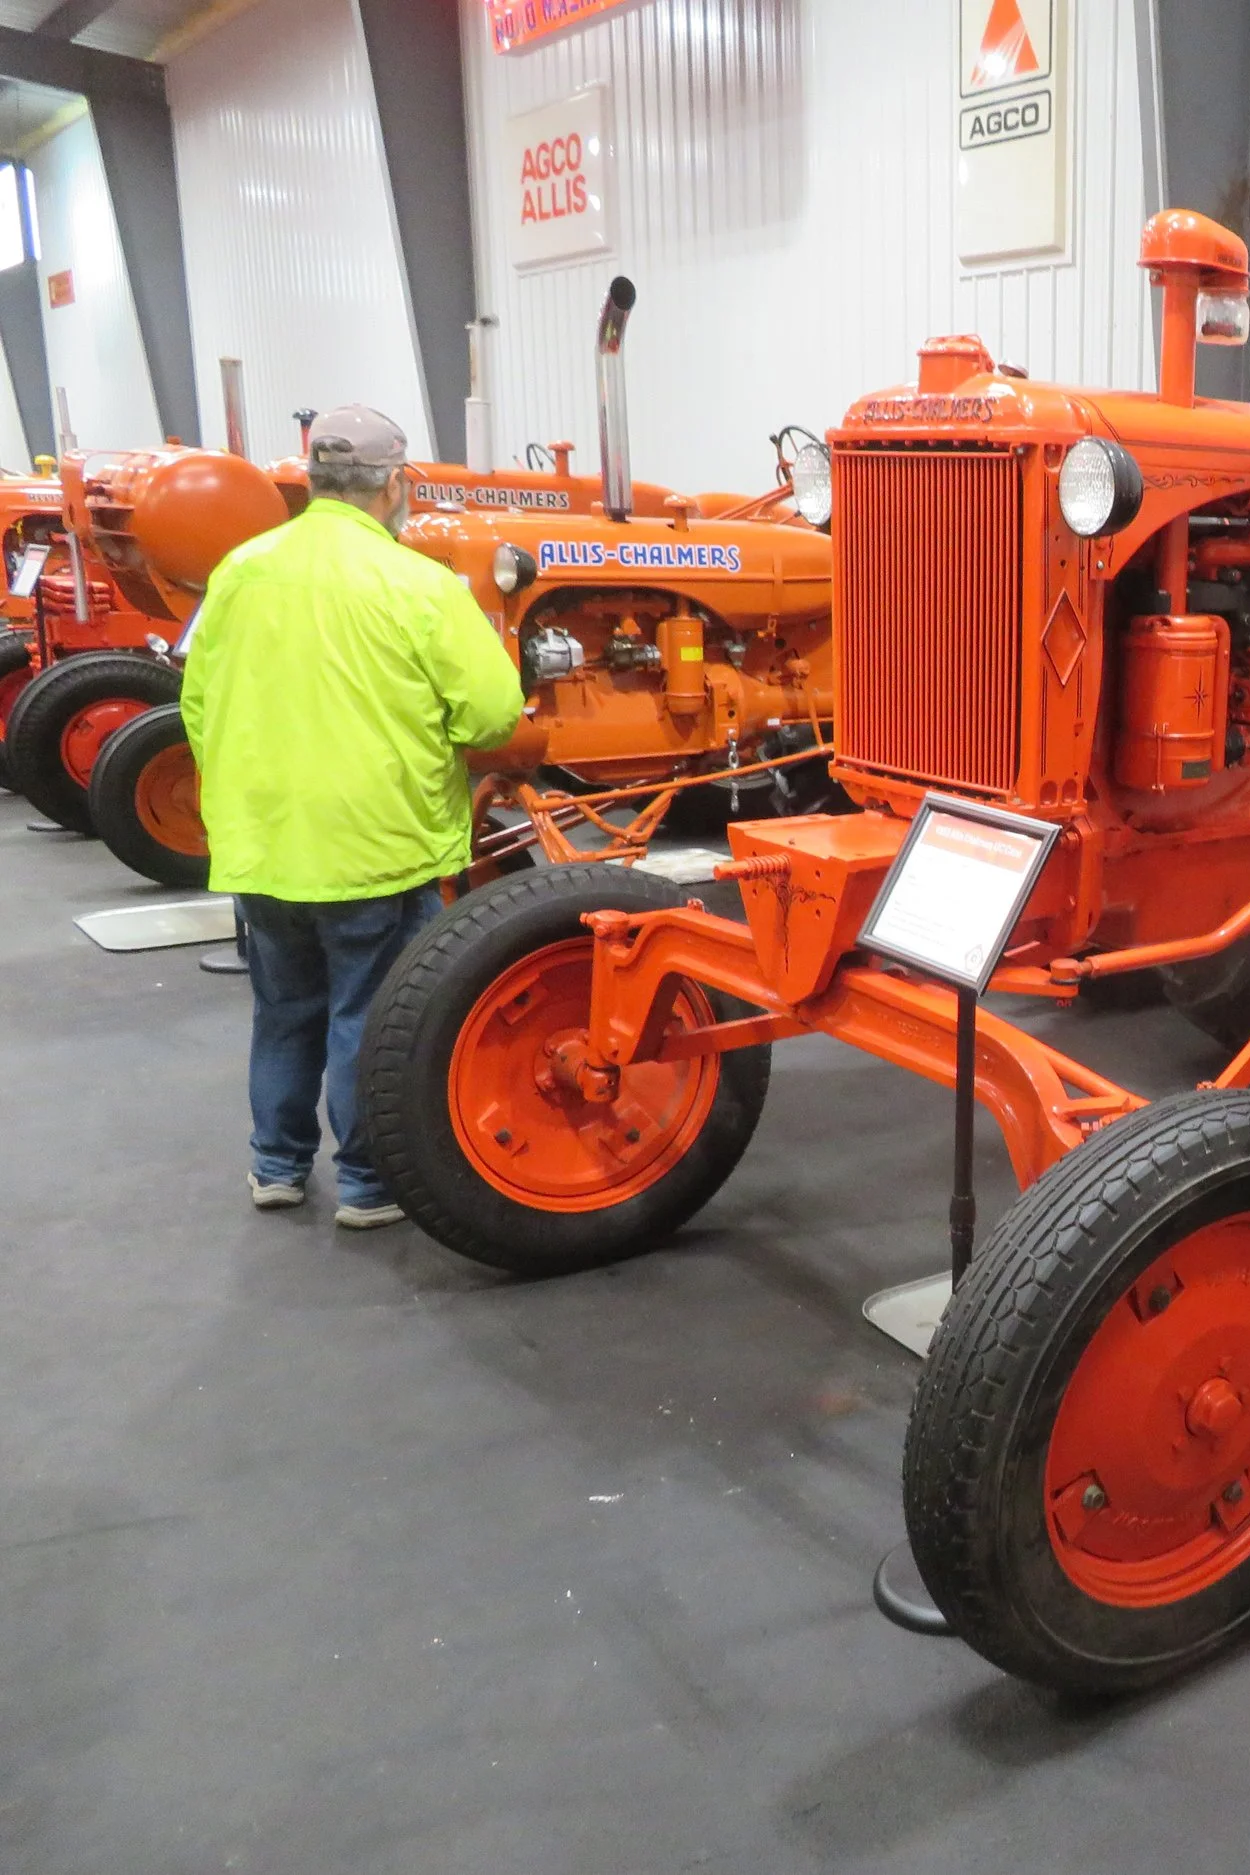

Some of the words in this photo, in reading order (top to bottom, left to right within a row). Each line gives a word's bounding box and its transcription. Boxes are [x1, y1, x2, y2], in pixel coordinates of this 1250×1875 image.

[970, 102, 1039, 140] AGCO
[521, 133, 582, 185] AGCO
[521, 174, 588, 226] ALLIS
[416, 484, 569, 509] ALLIS-CHALMERS
[540, 542, 741, 571] ALLIS-CHALMERS
